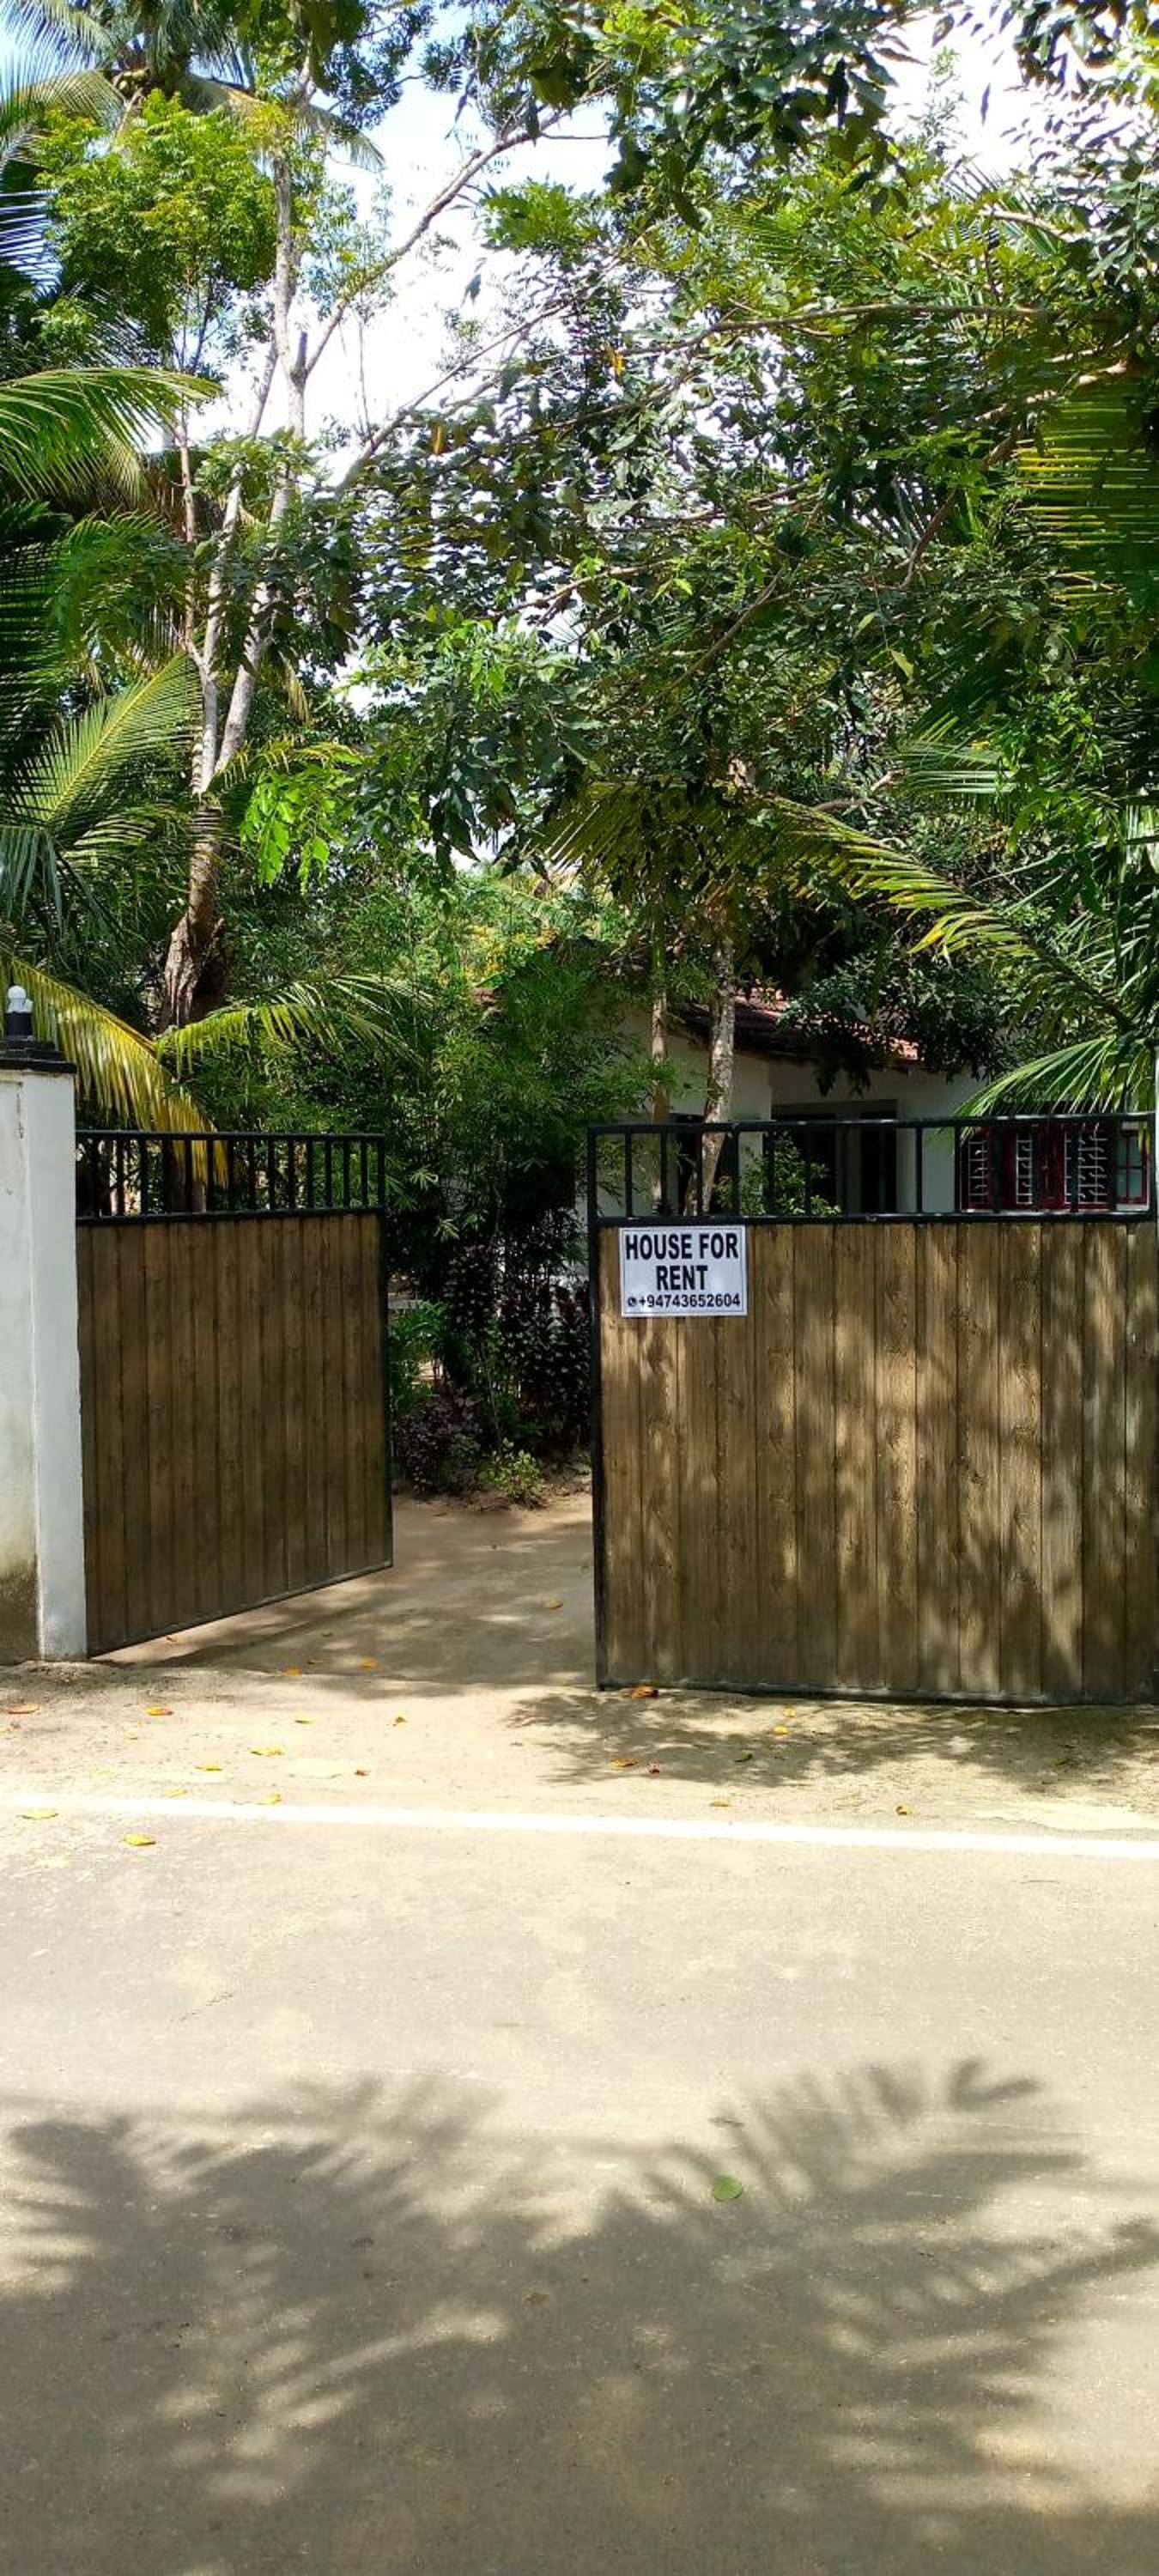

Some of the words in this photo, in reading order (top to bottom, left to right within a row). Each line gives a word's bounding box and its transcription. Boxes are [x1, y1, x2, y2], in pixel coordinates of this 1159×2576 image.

[625, 1233, 693, 1260] HOUSE
[699, 1232, 739, 1259] FOR
[655, 1265, 708, 1291] RENT
[638, 1292, 741, 1308] +94743652604
